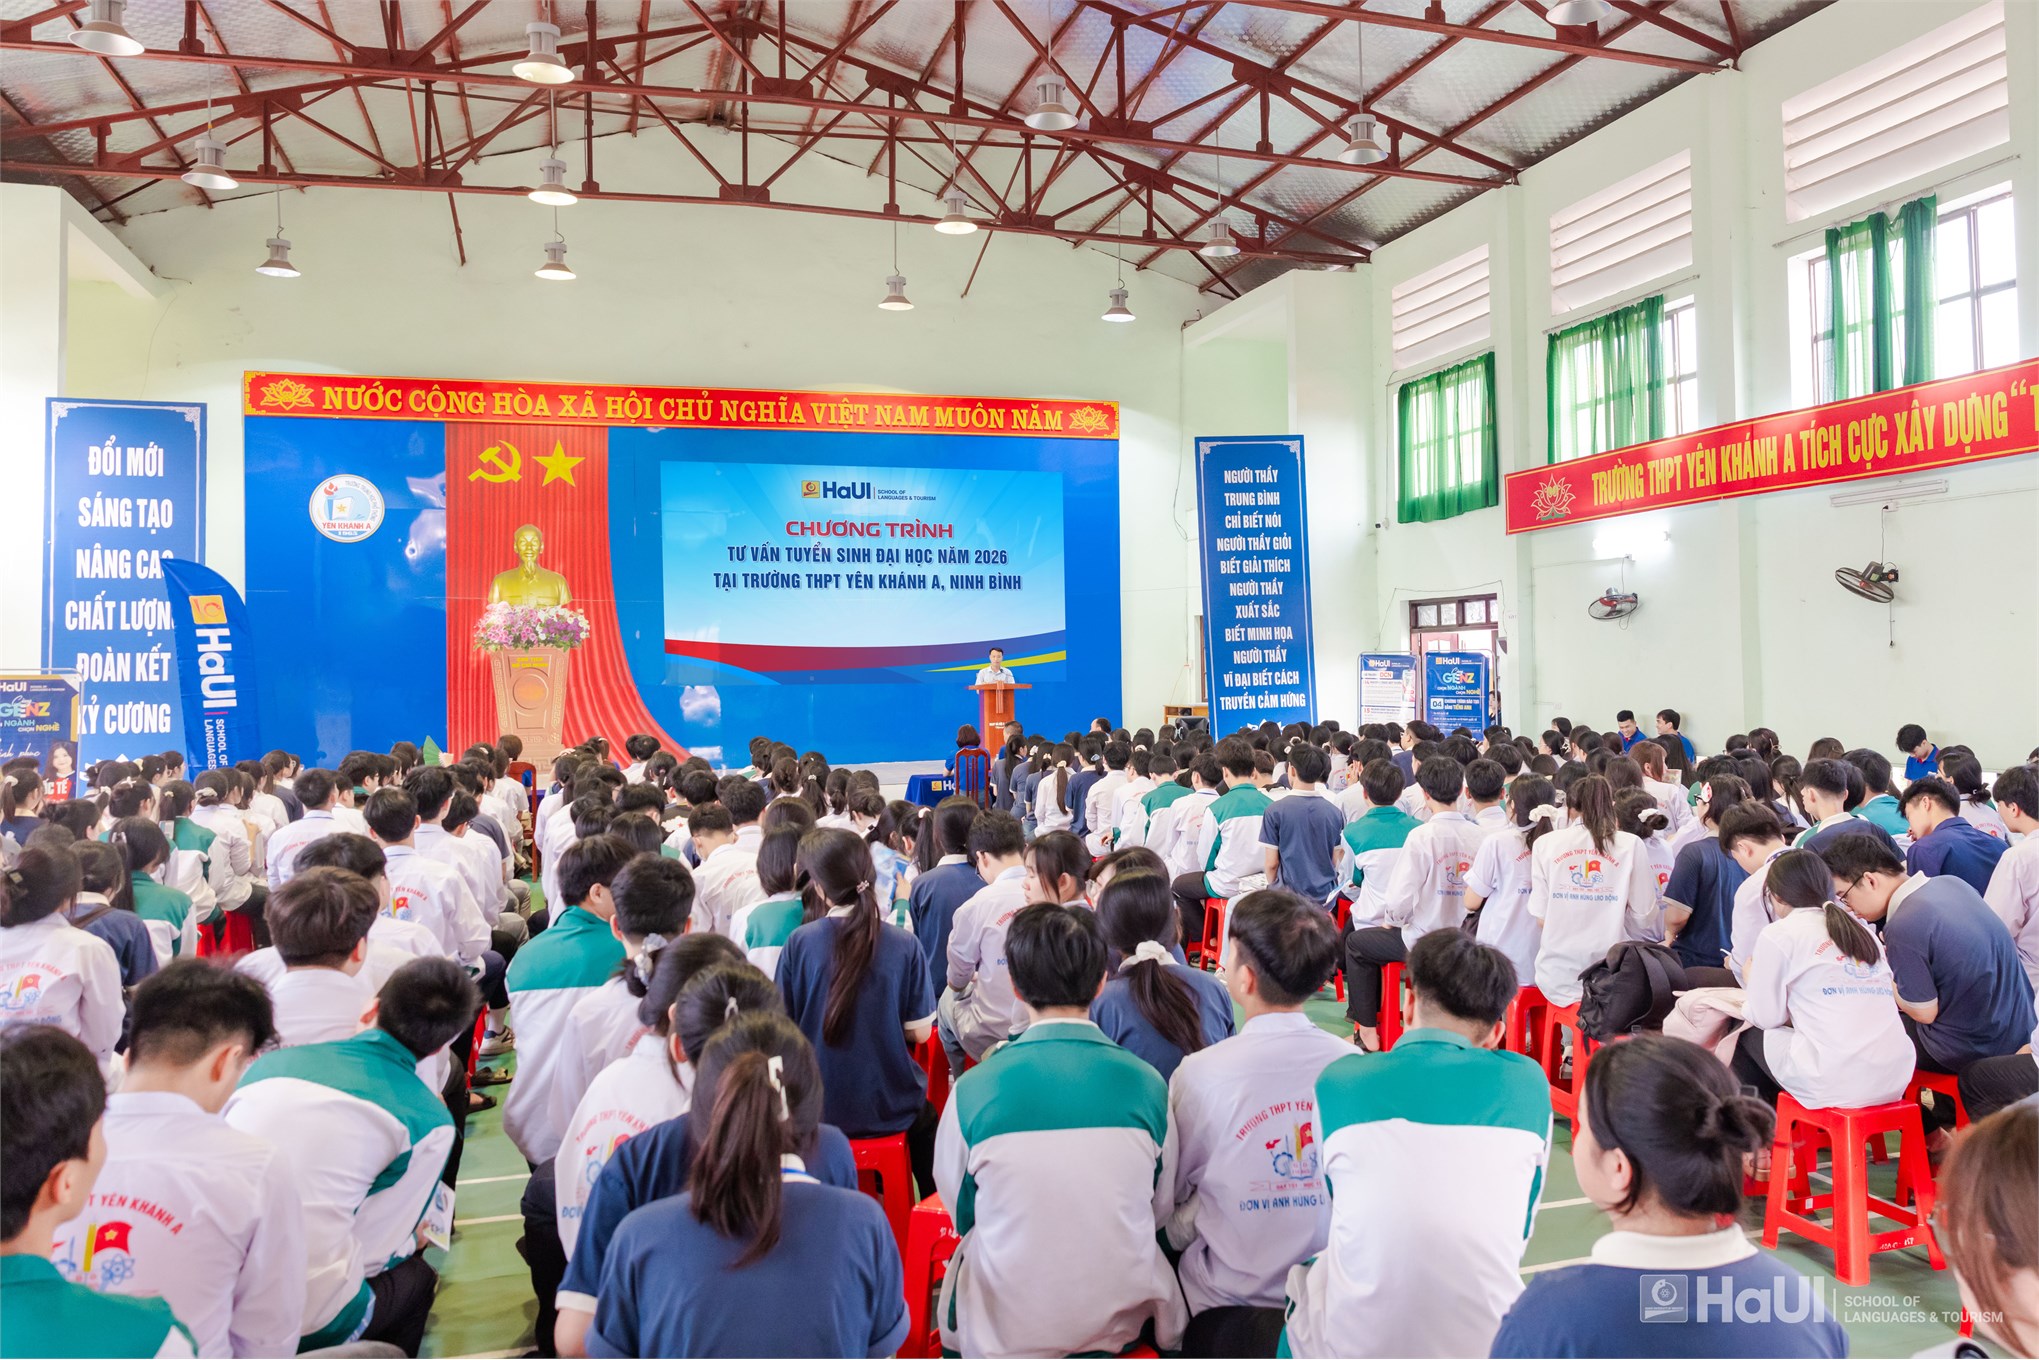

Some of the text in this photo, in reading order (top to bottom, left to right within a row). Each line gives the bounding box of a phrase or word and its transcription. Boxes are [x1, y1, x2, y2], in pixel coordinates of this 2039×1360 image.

[323, 381, 1064, 431] NƯỚC CỘNG HÒA XÃ HỘI CHỦ NGHĨA VIỆT NAM MUÔN NĂM
[88, 434, 164, 477] ĐỔI MỚI
[1592, 458, 1645, 507] TRƯỜNG
[1648, 453, 1683, 496] THPT
[1686, 442, 1717, 489] YÊN
[1721, 432, 1778, 483] KHÁNH
[1783, 433, 1796, 474] A
[1800, 420, 1842, 471] TÍCH
[1847, 412, 1888, 470] CỰC
[1894, 399, 1936, 456] XÂY
[1943, 392, 2009, 454] DỰNG
[1224, 465, 1279, 484] NGƯỜI THẦY
[822, 481, 871, 499] HaUI
[1224, 489, 1280, 506] TRUNG BÌNH
[78, 491, 173, 535] SÁNG TẠO
[1225, 510, 1282, 529] CHỈ BIẾT NÓI
[786, 518, 952, 538] CHƯƠNG TRÌNH
[1216, 532, 1292, 552] NGƯỜI THẦY GIỎI
[76, 543, 132, 579] NÂNG
[727, 541, 1008, 566] TƯ VẤN TUYỂN SINH ĐẠI HỌC NĂM 2026
[1220, 555, 1291, 574] BIẾT GIẢI THÍCH
[713, 569, 1021, 591] TẠI TRƯỜNG THPT YÊN KHÁNH A, NINH BÌNH
[1229, 577, 1284, 596] NGƯỜI THẦY
[65, 590, 175, 637] CHẤT LƯỢN
[1235, 599, 1280, 619] XUẤT SẮC
[1225, 624, 1293, 643] BIẾT MINH HỌA
[76, 643, 171, 683] ĐOÀN KẾT
[1233, 645, 1287, 664] NGƯỜI THẦY
[1442, 657, 1460, 665] HaUI
[195, 628, 237, 709] HaUI
[1442, 672, 1475, 684] GENZ
[1223, 668, 1299, 690] VĨ ĐẠI BIẾT CÁCH
[0, 702, 50, 718] GENZ
[1220, 691, 1306, 710] TRUYỀN CẢM HỨNG
[4, 718, 35, 727] NGÀNH
[36, 722, 60, 732] NGHỀ
[104, 701, 171, 735] CƯƠNG
[204, 719, 217, 770] LANGUAGES
[215, 719, 228, 766] SCHOOL OF
[1822, 987, 1837, 996] ĐƠN
[1269, 1102, 1291, 1116] THPT
[101, 1192, 183, 1235] YÊN KHÁNH A
[1240, 1199, 1259, 1211] ĐƠN
[1272, 1197, 1290, 1208] ANH
